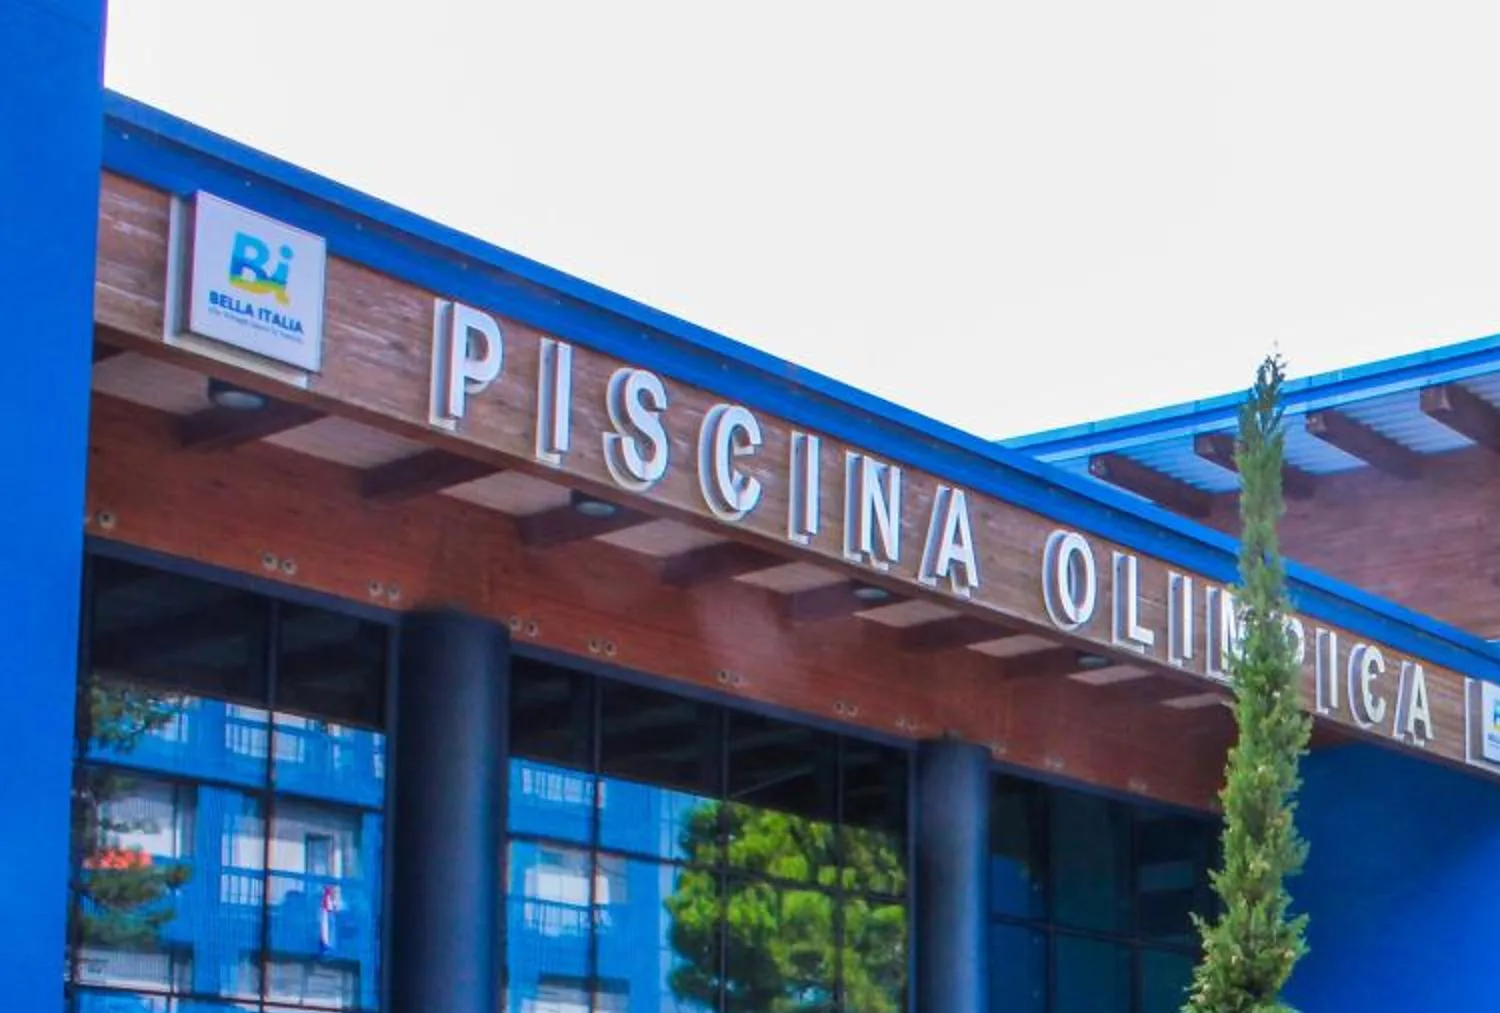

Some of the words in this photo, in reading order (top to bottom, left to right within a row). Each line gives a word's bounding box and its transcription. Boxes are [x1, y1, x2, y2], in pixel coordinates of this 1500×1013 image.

[209, 290, 255, 319] BELLA
[258, 308, 304, 334] ITALIA
[430, 298, 980, 598] PISCINA
